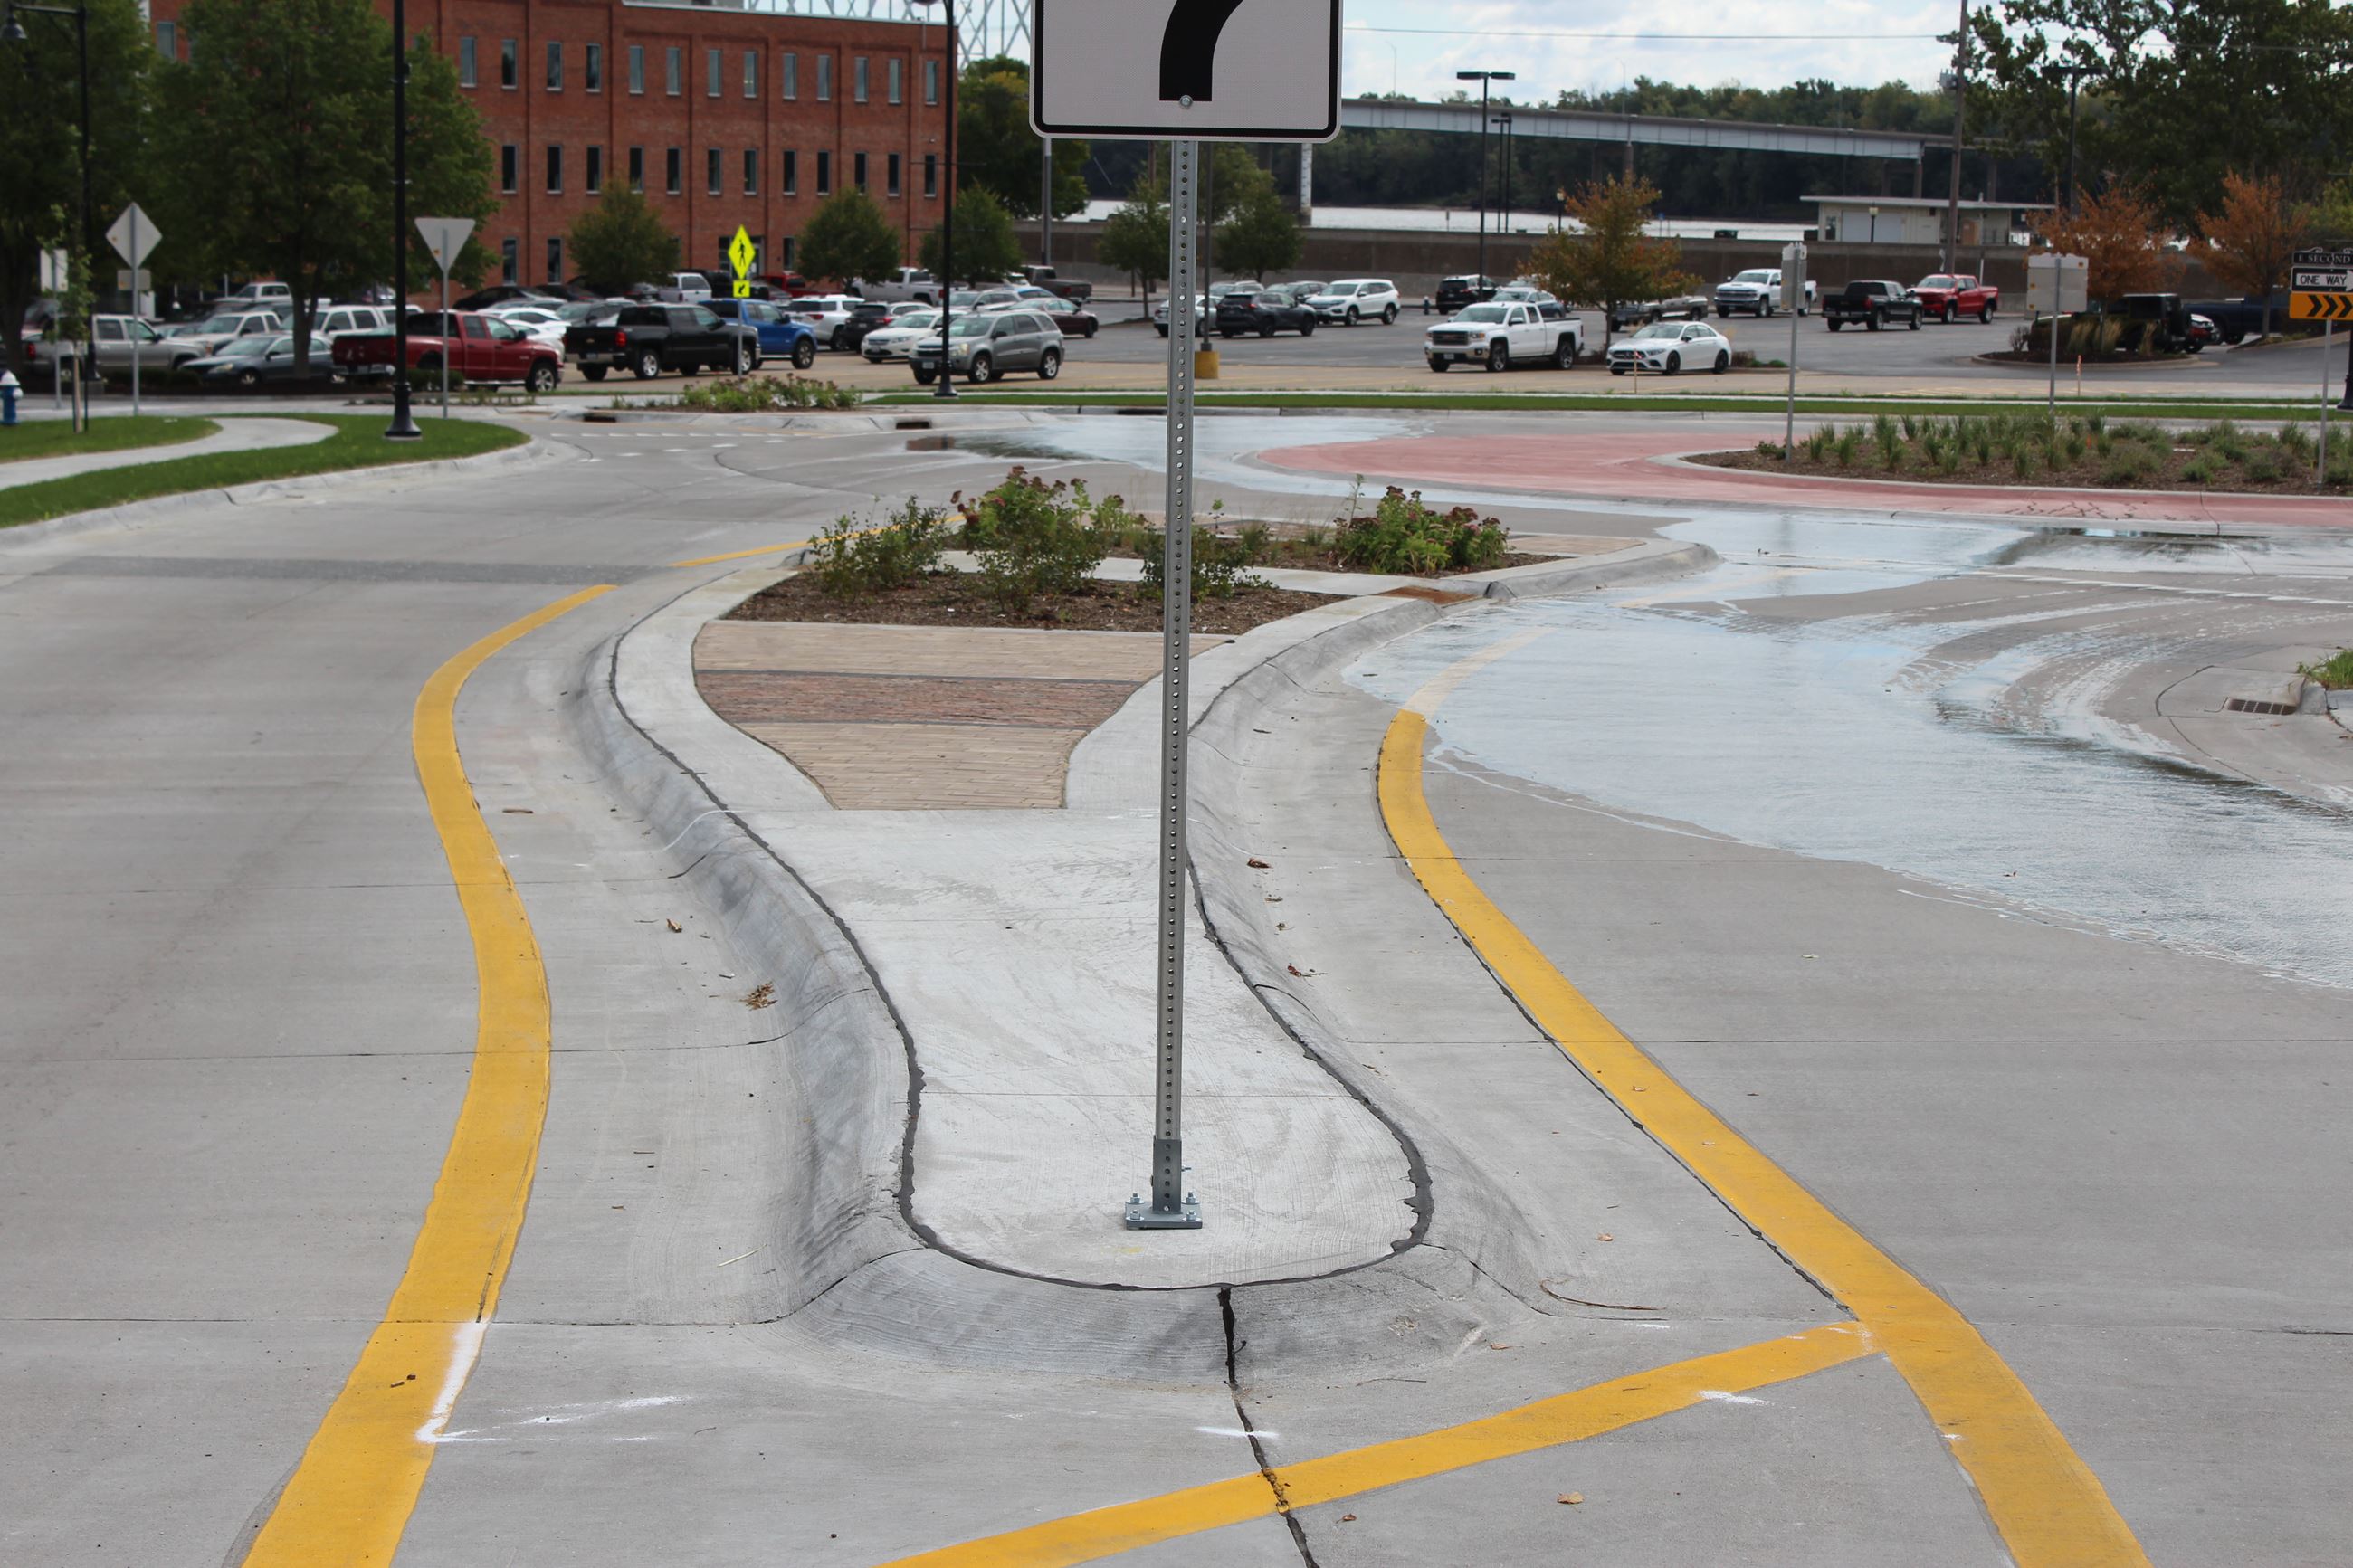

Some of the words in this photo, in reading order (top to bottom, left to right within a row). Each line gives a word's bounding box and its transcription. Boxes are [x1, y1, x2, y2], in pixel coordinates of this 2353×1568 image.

[2308, 254, 2351, 263] SECOND
[2300, 275, 2320, 285] ONE
[2326, 275, 2347, 285] WAY
